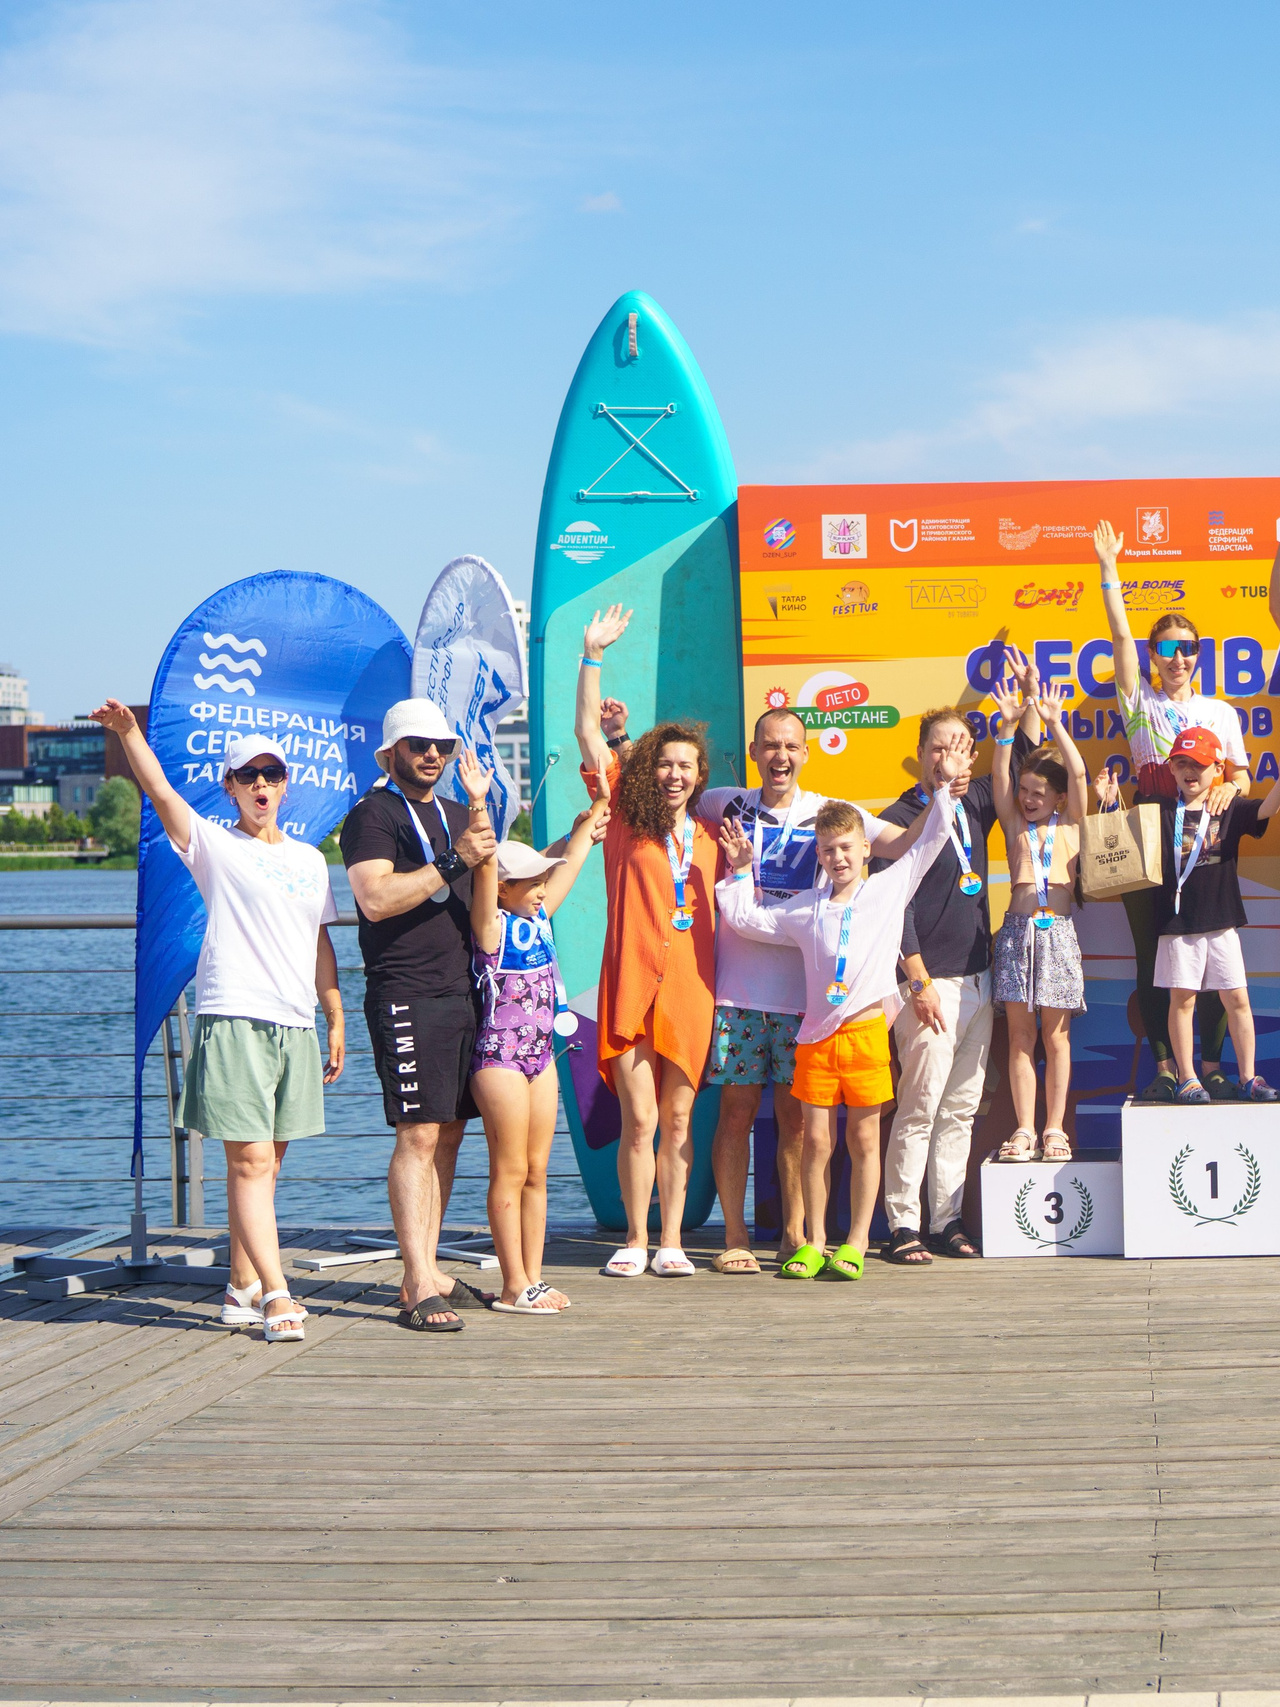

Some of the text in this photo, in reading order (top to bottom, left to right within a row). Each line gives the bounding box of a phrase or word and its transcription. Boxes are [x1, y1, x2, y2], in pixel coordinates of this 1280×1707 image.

[1042, 531, 1074, 539] «СТАРЫЙ
[1208, 528, 1254, 536] ФЕДЕРАЦИЯ
[557, 535, 609, 544] ADVENTUM
[1208, 536, 1248, 544] СЕРФИНГА
[1124, 548, 1182, 557] Мэрия Казани
[1208, 544, 1253, 552] ТАТАРСТАНА
[1121, 580, 1185, 590] НА ВОЛНЕ
[781, 595, 807, 603] ТАТАР
[832, 602, 878, 615] FEST TUR
[825, 687, 861, 707] ЛЕТО
[189, 701, 366, 743] ФЕДЕРАЦИЯ
[186, 730, 344, 763] СЕРИНГА
[1108, 849, 1130, 858] BARS
[1098, 854, 1127, 866] SHOP
[391, 1004, 421, 1113] TERMIT
[1205, 1161, 1218, 1199] 1
[1044, 1191, 1065, 1225] 3
